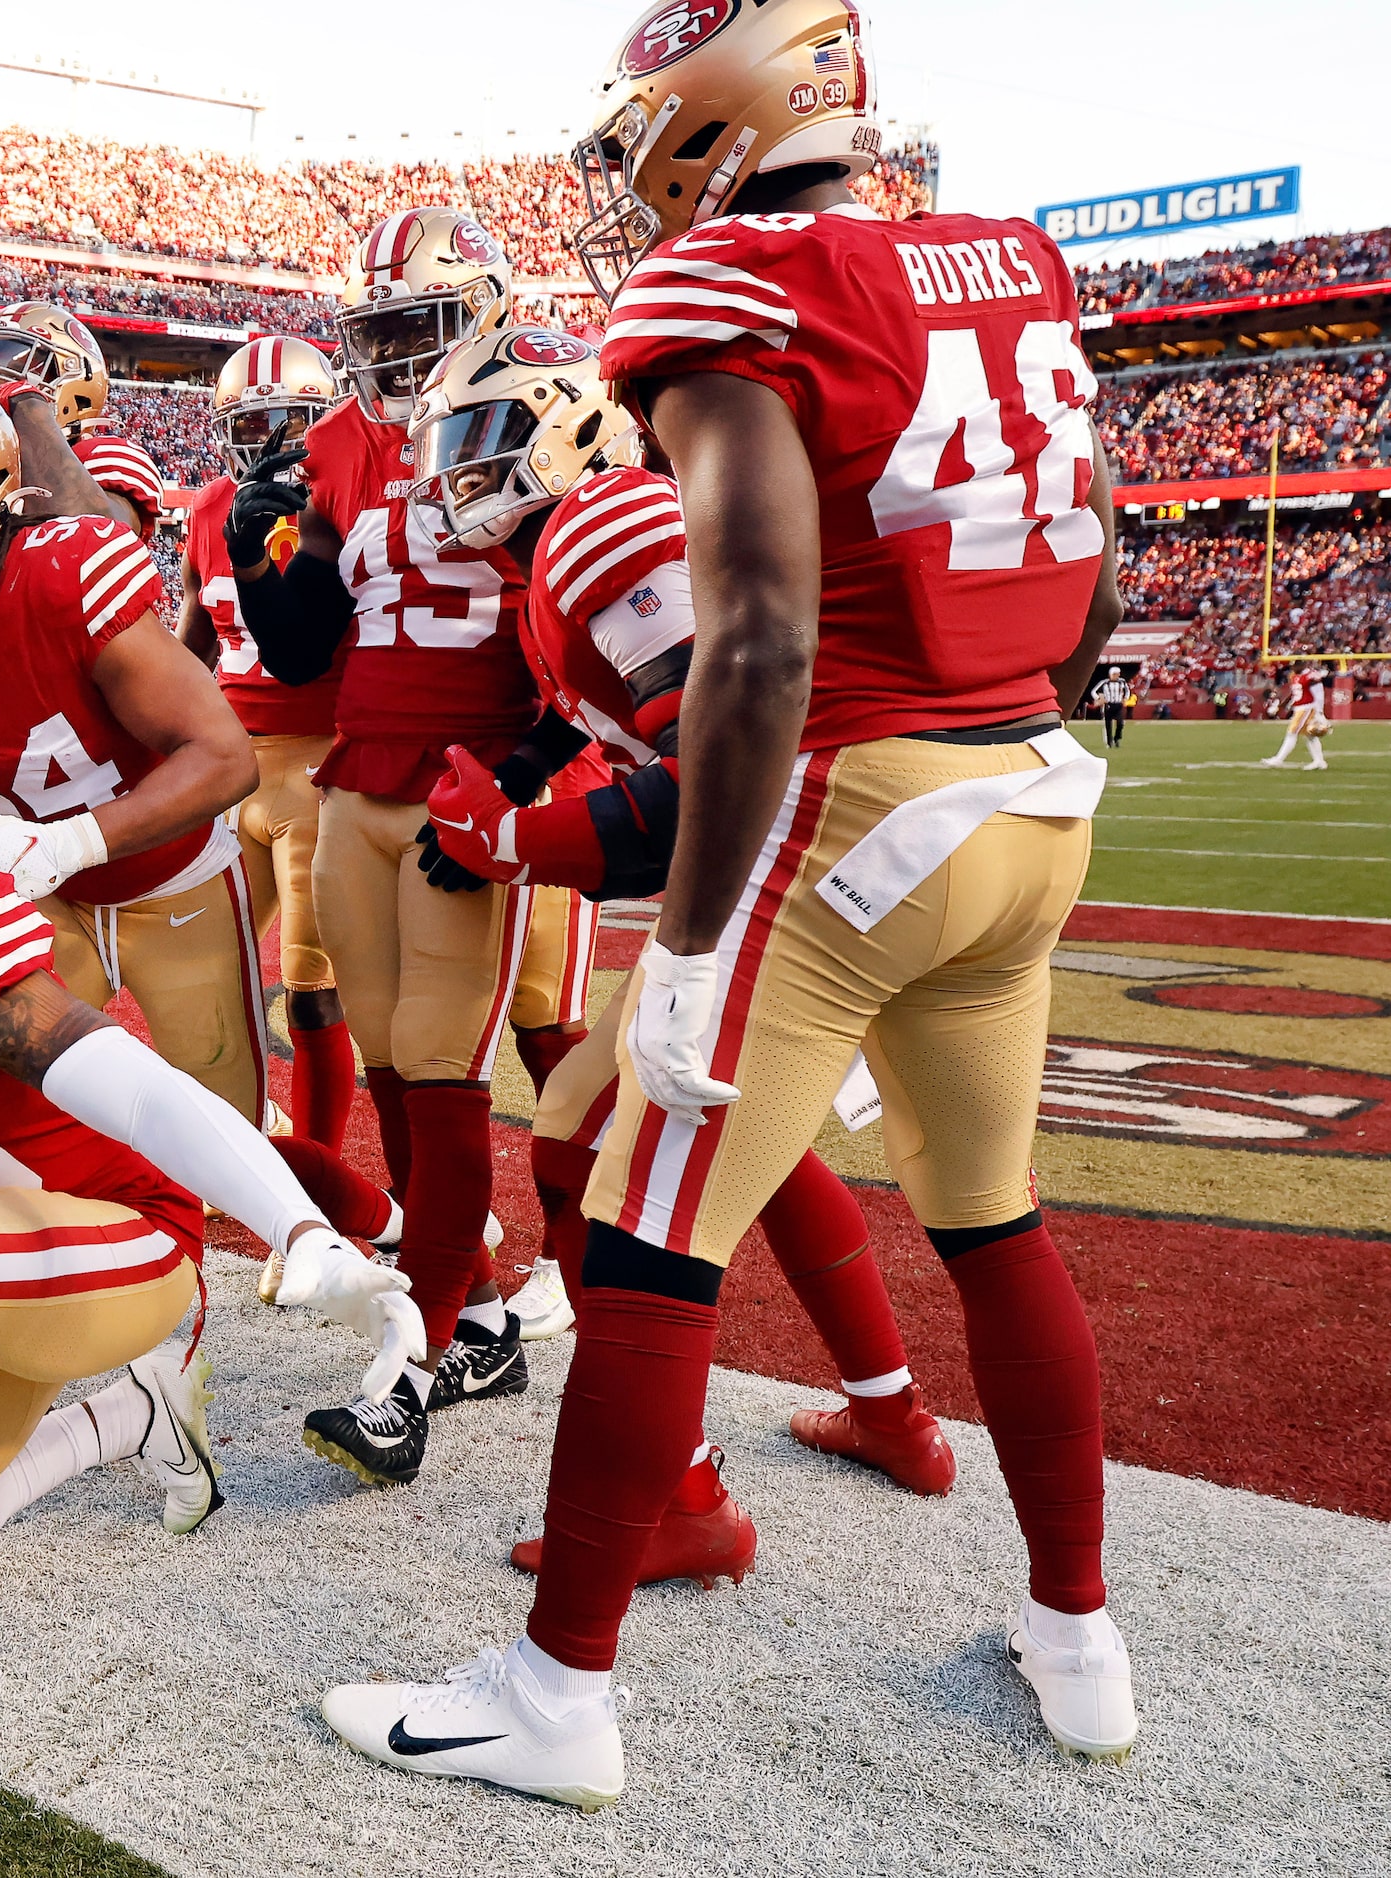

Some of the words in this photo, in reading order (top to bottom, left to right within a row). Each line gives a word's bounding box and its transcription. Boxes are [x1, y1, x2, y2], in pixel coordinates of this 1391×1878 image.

[792, 87, 816, 110] JM
[825, 83, 845, 104] 39
[733, 142, 747, 157] 48
[894, 236, 1044, 306] BURKS
[167, 322, 249, 344] INTERCEPTION
[867, 319, 1106, 571] 48
[337, 507, 505, 649] 45
[636, 596, 661, 615] NFL
[830, 875, 849, 893] WE
